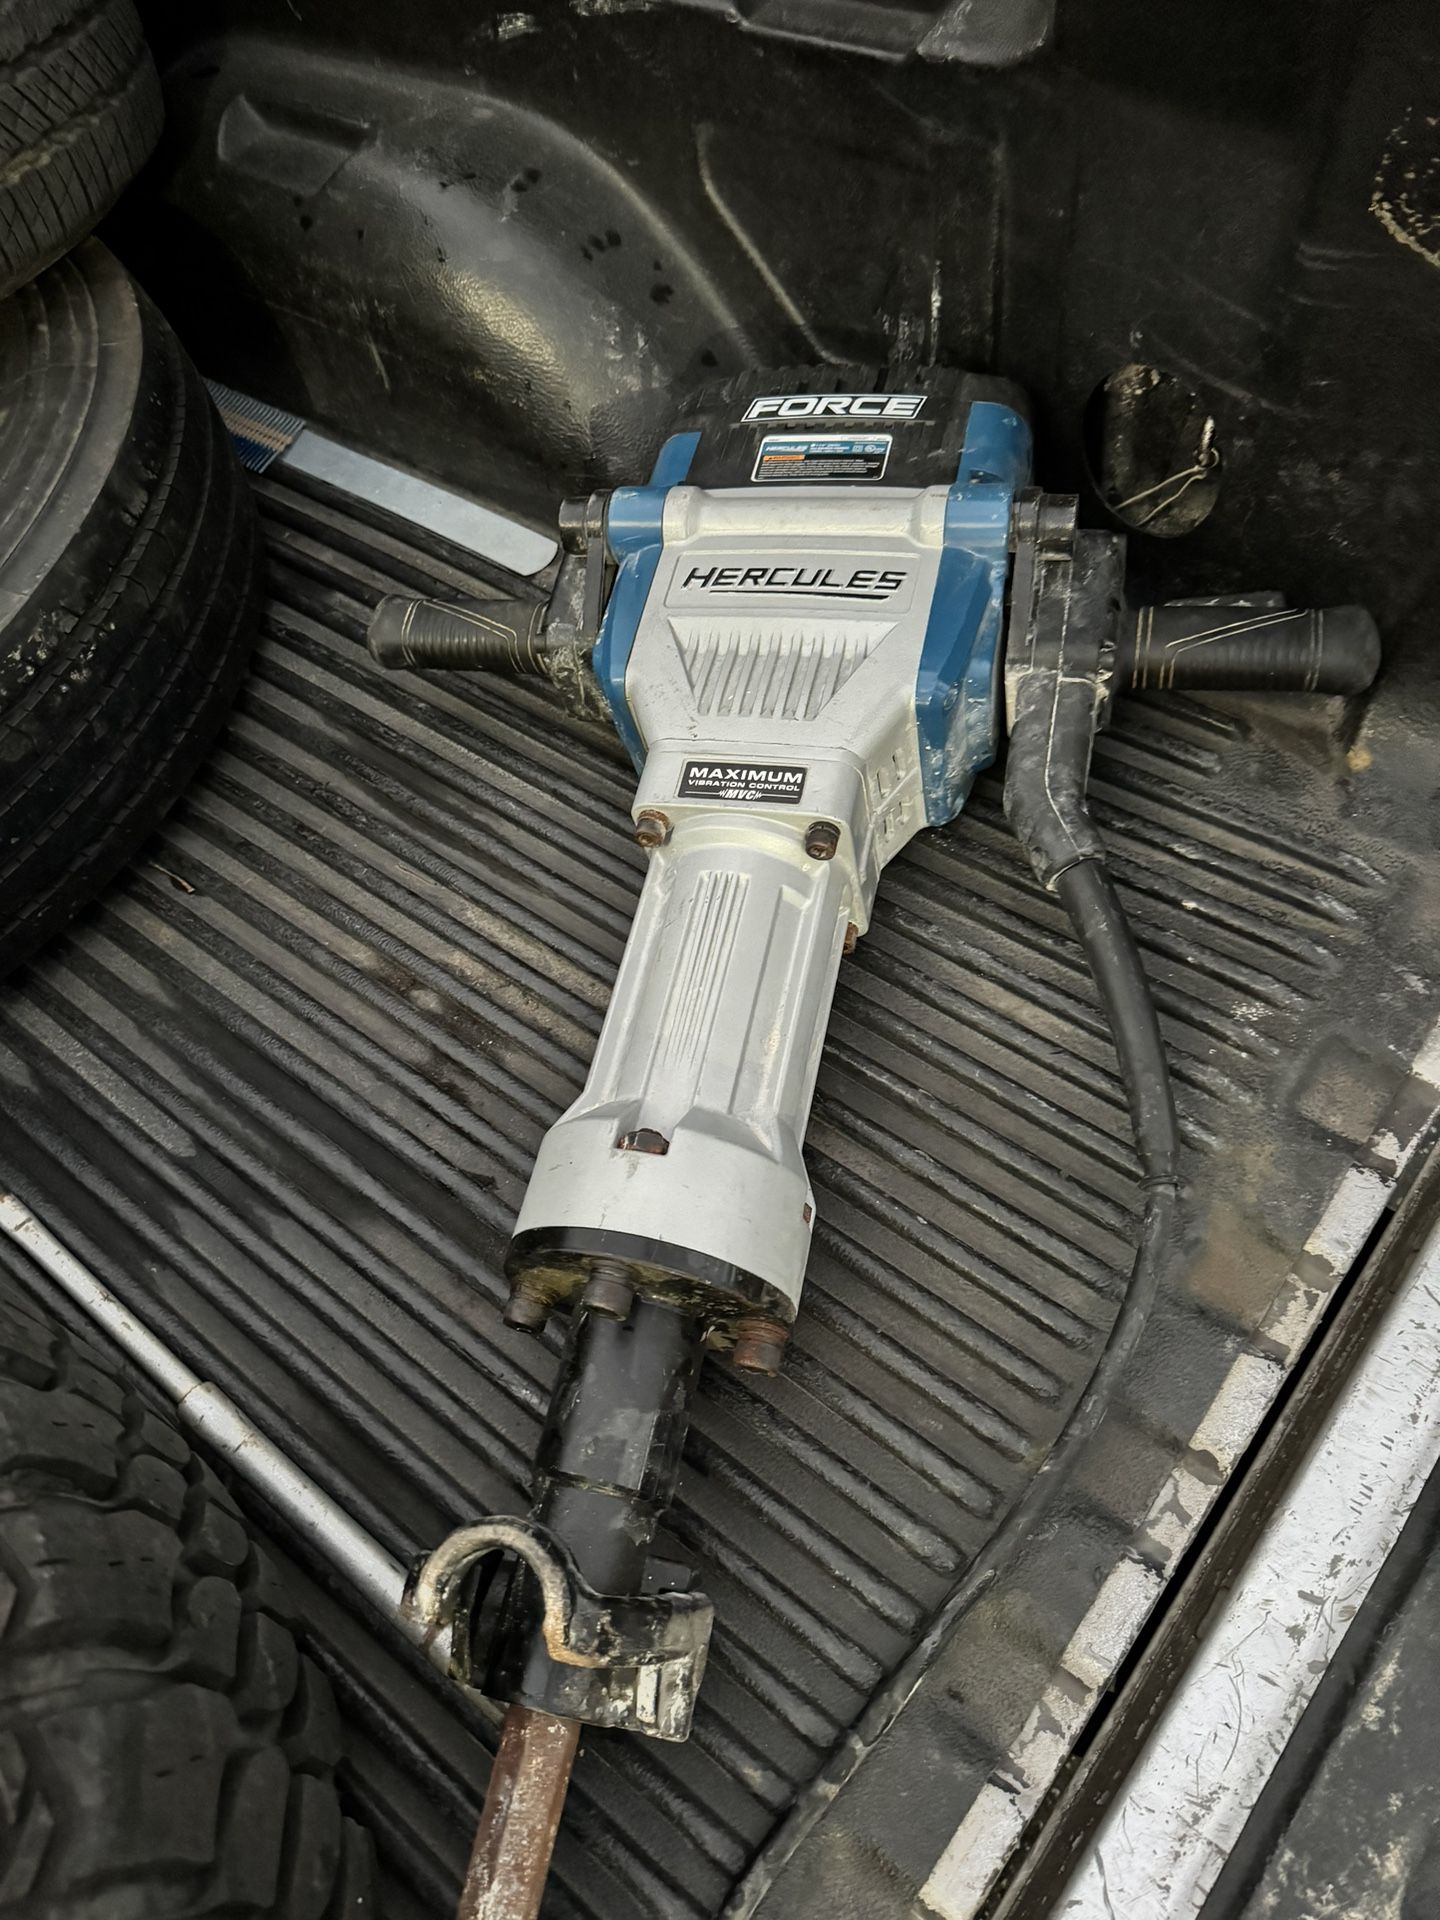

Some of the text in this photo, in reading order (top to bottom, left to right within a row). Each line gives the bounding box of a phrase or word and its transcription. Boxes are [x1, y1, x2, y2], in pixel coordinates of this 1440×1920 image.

[747, 397, 922, 418] FORCE
[682, 567, 907, 590] HERCULES
[690, 767, 803, 783] MAXIMUM
[688, 779, 800, 791] VIBRATION CONTROL
[725, 789, 756, 800] MVC
